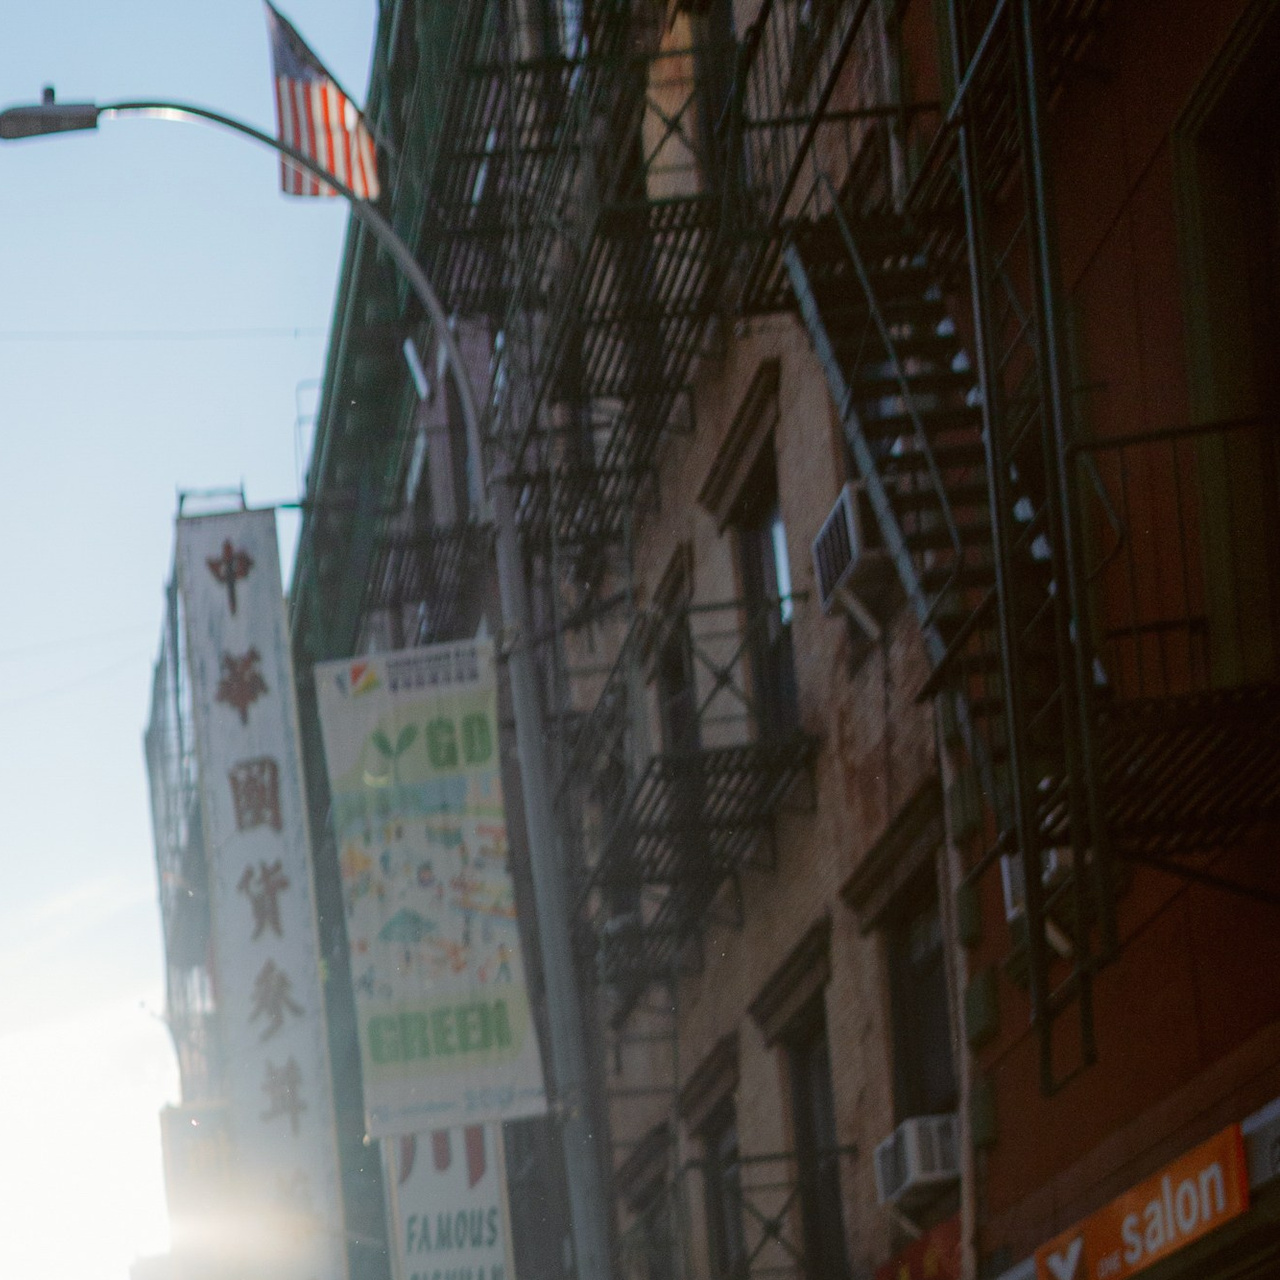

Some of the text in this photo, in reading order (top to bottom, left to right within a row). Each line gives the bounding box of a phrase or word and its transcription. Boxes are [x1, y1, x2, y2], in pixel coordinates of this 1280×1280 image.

[367, 998, 512, 1065] GREEN
[406, 1205, 498, 1254] FAMOUS
[1121, 1161, 1225, 1265] salon
